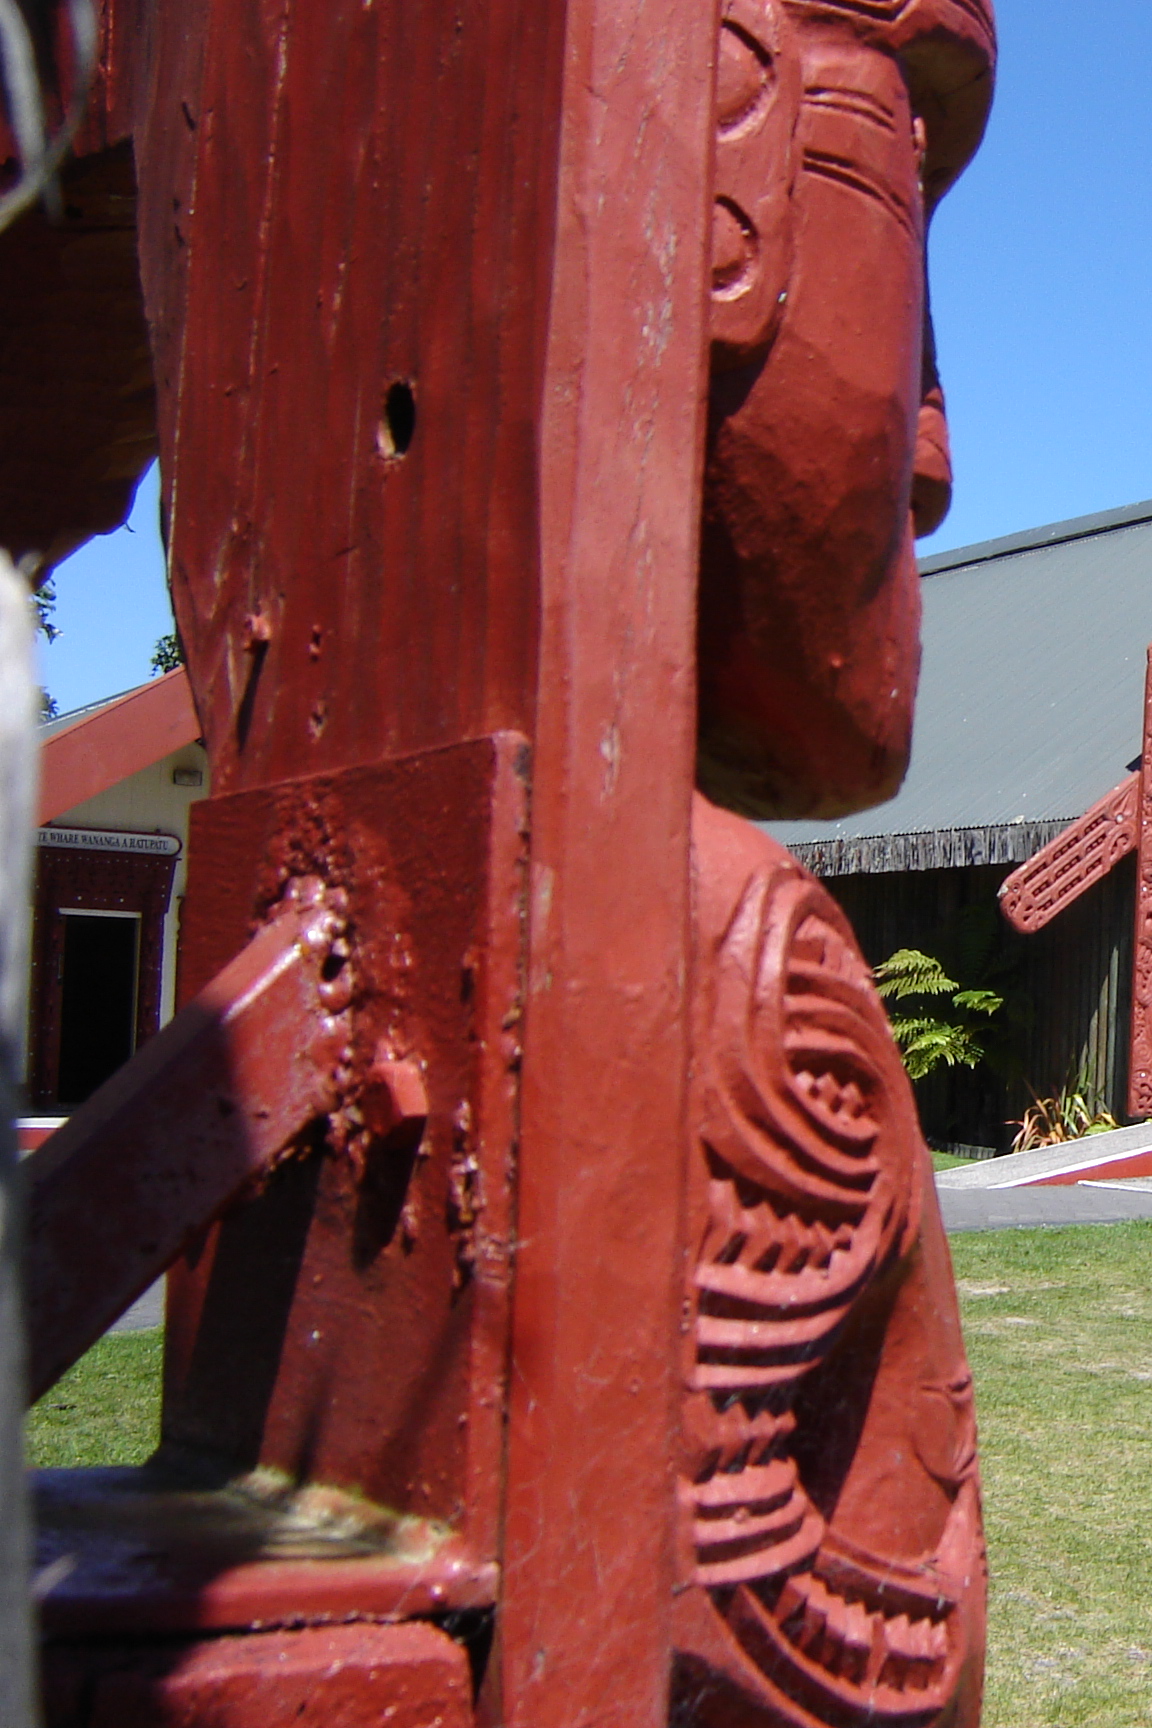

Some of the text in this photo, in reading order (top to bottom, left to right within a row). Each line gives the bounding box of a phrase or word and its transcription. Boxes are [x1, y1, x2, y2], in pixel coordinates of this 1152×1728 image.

[50, 832, 78, 844] WHARE
[81, 834, 120, 847] WANANGA
[122, 838, 127, 848] A
[129, 838, 168, 851] HATUPATU
